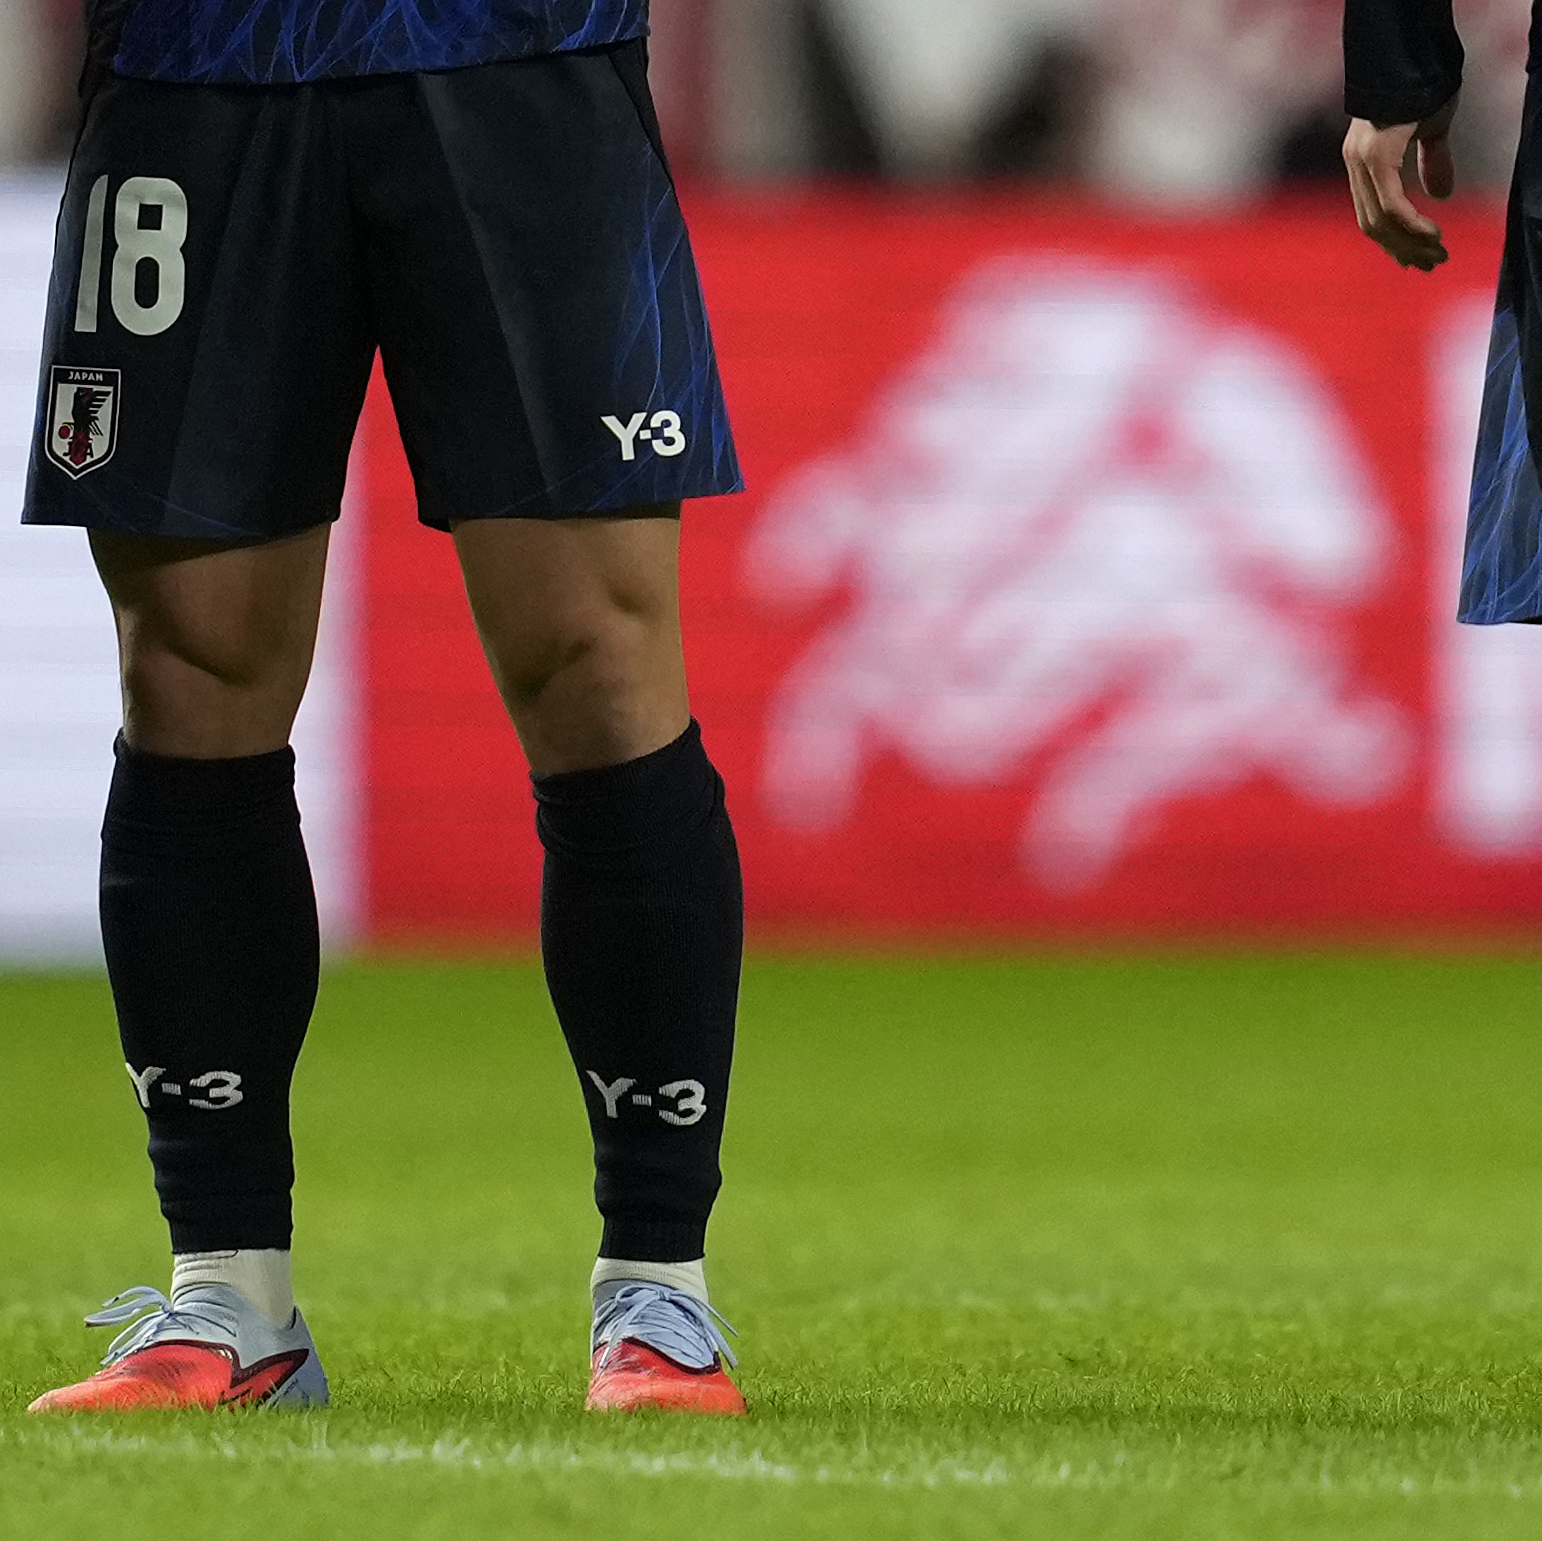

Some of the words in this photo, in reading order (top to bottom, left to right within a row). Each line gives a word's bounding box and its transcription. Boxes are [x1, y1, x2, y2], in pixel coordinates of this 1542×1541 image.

[73, 173, 189, 337] 18
[68, 371, 104, 382] JAPAN
[599, 409, 687, 461] Y-3
[124, 1061, 244, 1110] Y-3
[585, 1069, 708, 1126] Y-3
